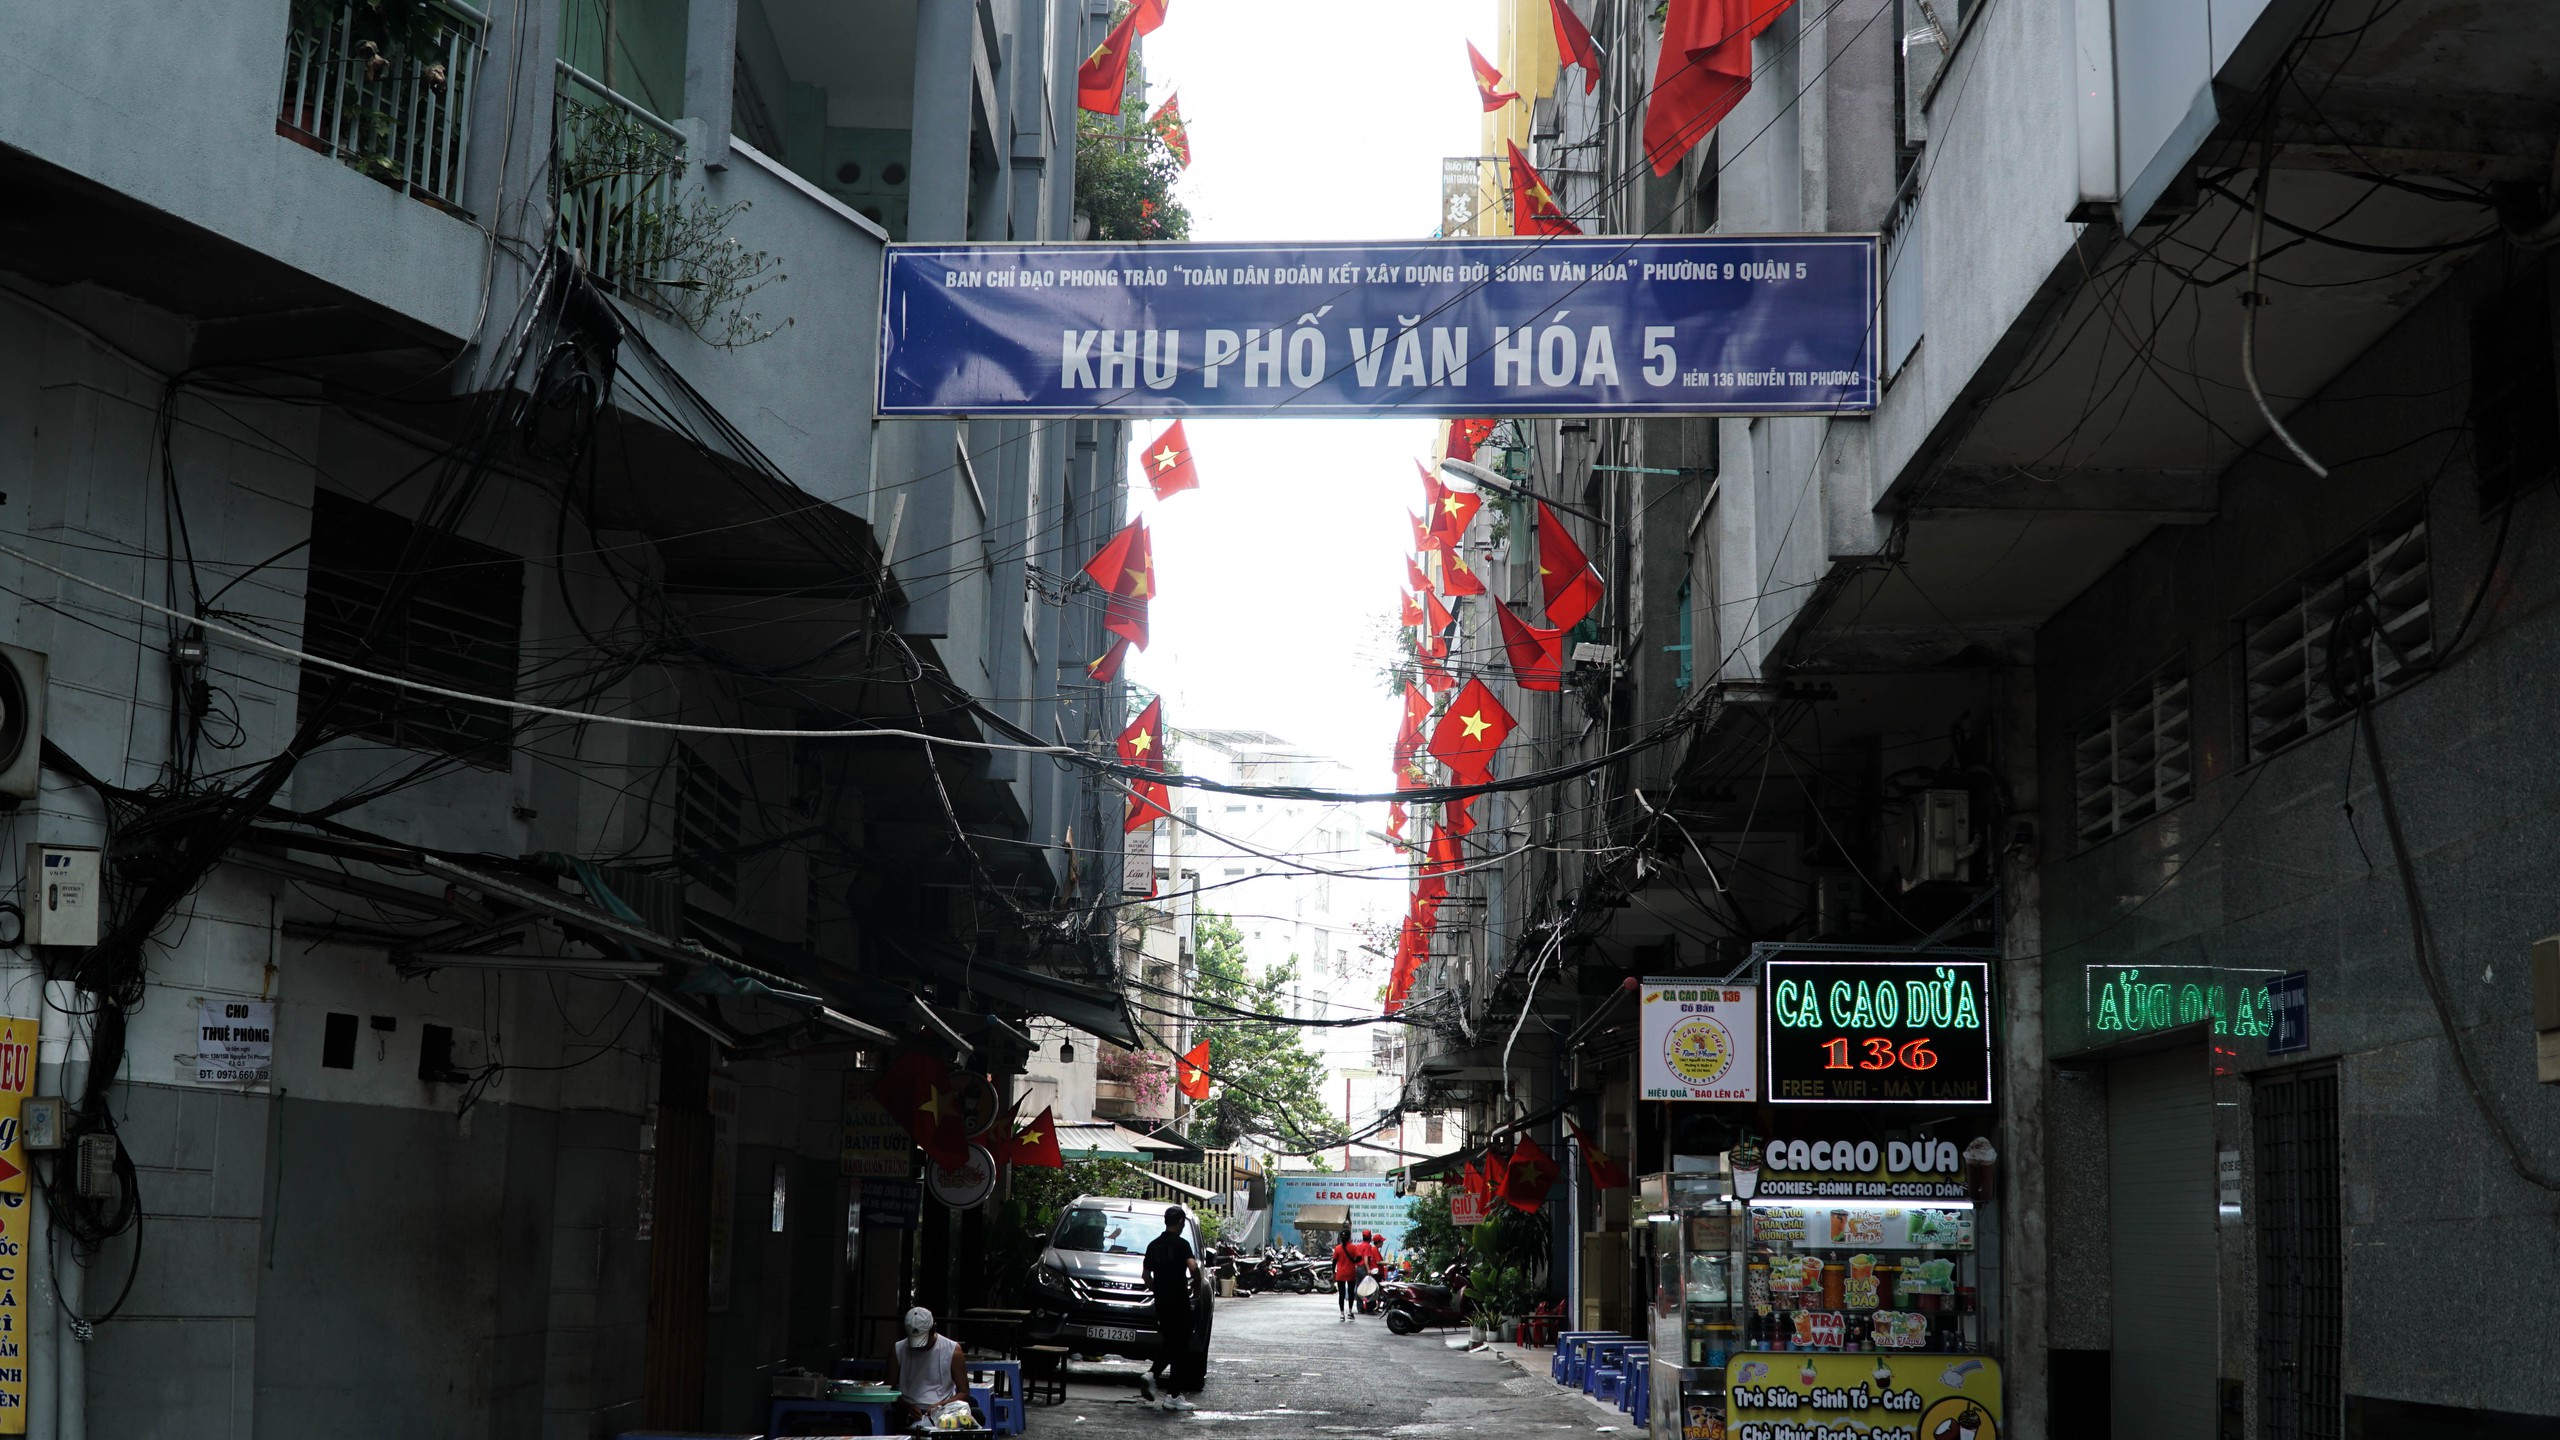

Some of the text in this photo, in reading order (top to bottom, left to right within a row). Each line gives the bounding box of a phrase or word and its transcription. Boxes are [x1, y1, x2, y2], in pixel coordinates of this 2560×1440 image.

[946, 269, 981, 288] BAN
[987, 265, 1014, 287] CHỈ
[1019, 269, 1055, 290] ĐẠO
[1059, 268, 1118, 287] PHONG
[1123, 266, 1168, 287] TRÀO
[1233, 263, 1269, 285] DÂN
[1274, 265, 1323, 285] ĐOÀN
[1328, 262, 1361, 284] KẾT
[1365, 263, 1401, 283] XÂY
[1405, 264, 1454, 286] DỰNG
[1459, 263, 1490, 282] ĐỜI
[1495, 260, 1544, 282] SỐNG
[1550, 261, 1586, 282] VĂN
[1643, 260, 1718, 281] PHƯỜNG
[1723, 263, 1734, 280] 9
[1740, 260, 1790, 283] QUẬN
[1795, 262, 1807, 280] 5
[1061, 305, 1677, 390] KHU PHỐ VĂN HÓA 5
[1683, 367, 1860, 387] HẺM 136 NGUYỄN TRI PHƯƠNG
[1663, 990, 1676, 1002] CA
[1678, 990, 1698, 1002] CAO
[1722, 991, 1741, 1002] 136
[1776, 966, 1980, 1028] CA CAO DỪA
[226, 1004, 249, 1018] CHO
[202, 1025, 270, 1042] THUÊ PHÒNG
[1820, 1037, 1938, 1070] 136
[217, 1070, 237, 1080] 0973
[239, 1070, 254, 1080] 660
[1648, 1088, 1668, 1098] HIỆU
[1670, 1087, 1687, 1097] QUẢ
[1714, 1088, 1731, 1098] LÊN
[1782, 1080, 1824, 1096] FREE
[844, 1130, 909, 1151] BÁNH ƯỚT
[1766, 1133, 1959, 1173] CACAO DỪA
[1330, 1191, 1344, 1200] RA
[1101, 1281, 1133, 1290] ISUZU
[1810, 1312, 1845, 1328] TRÀ
[1734, 1381, 1922, 1410] Trà Sữa Sinh Tố Cafe
